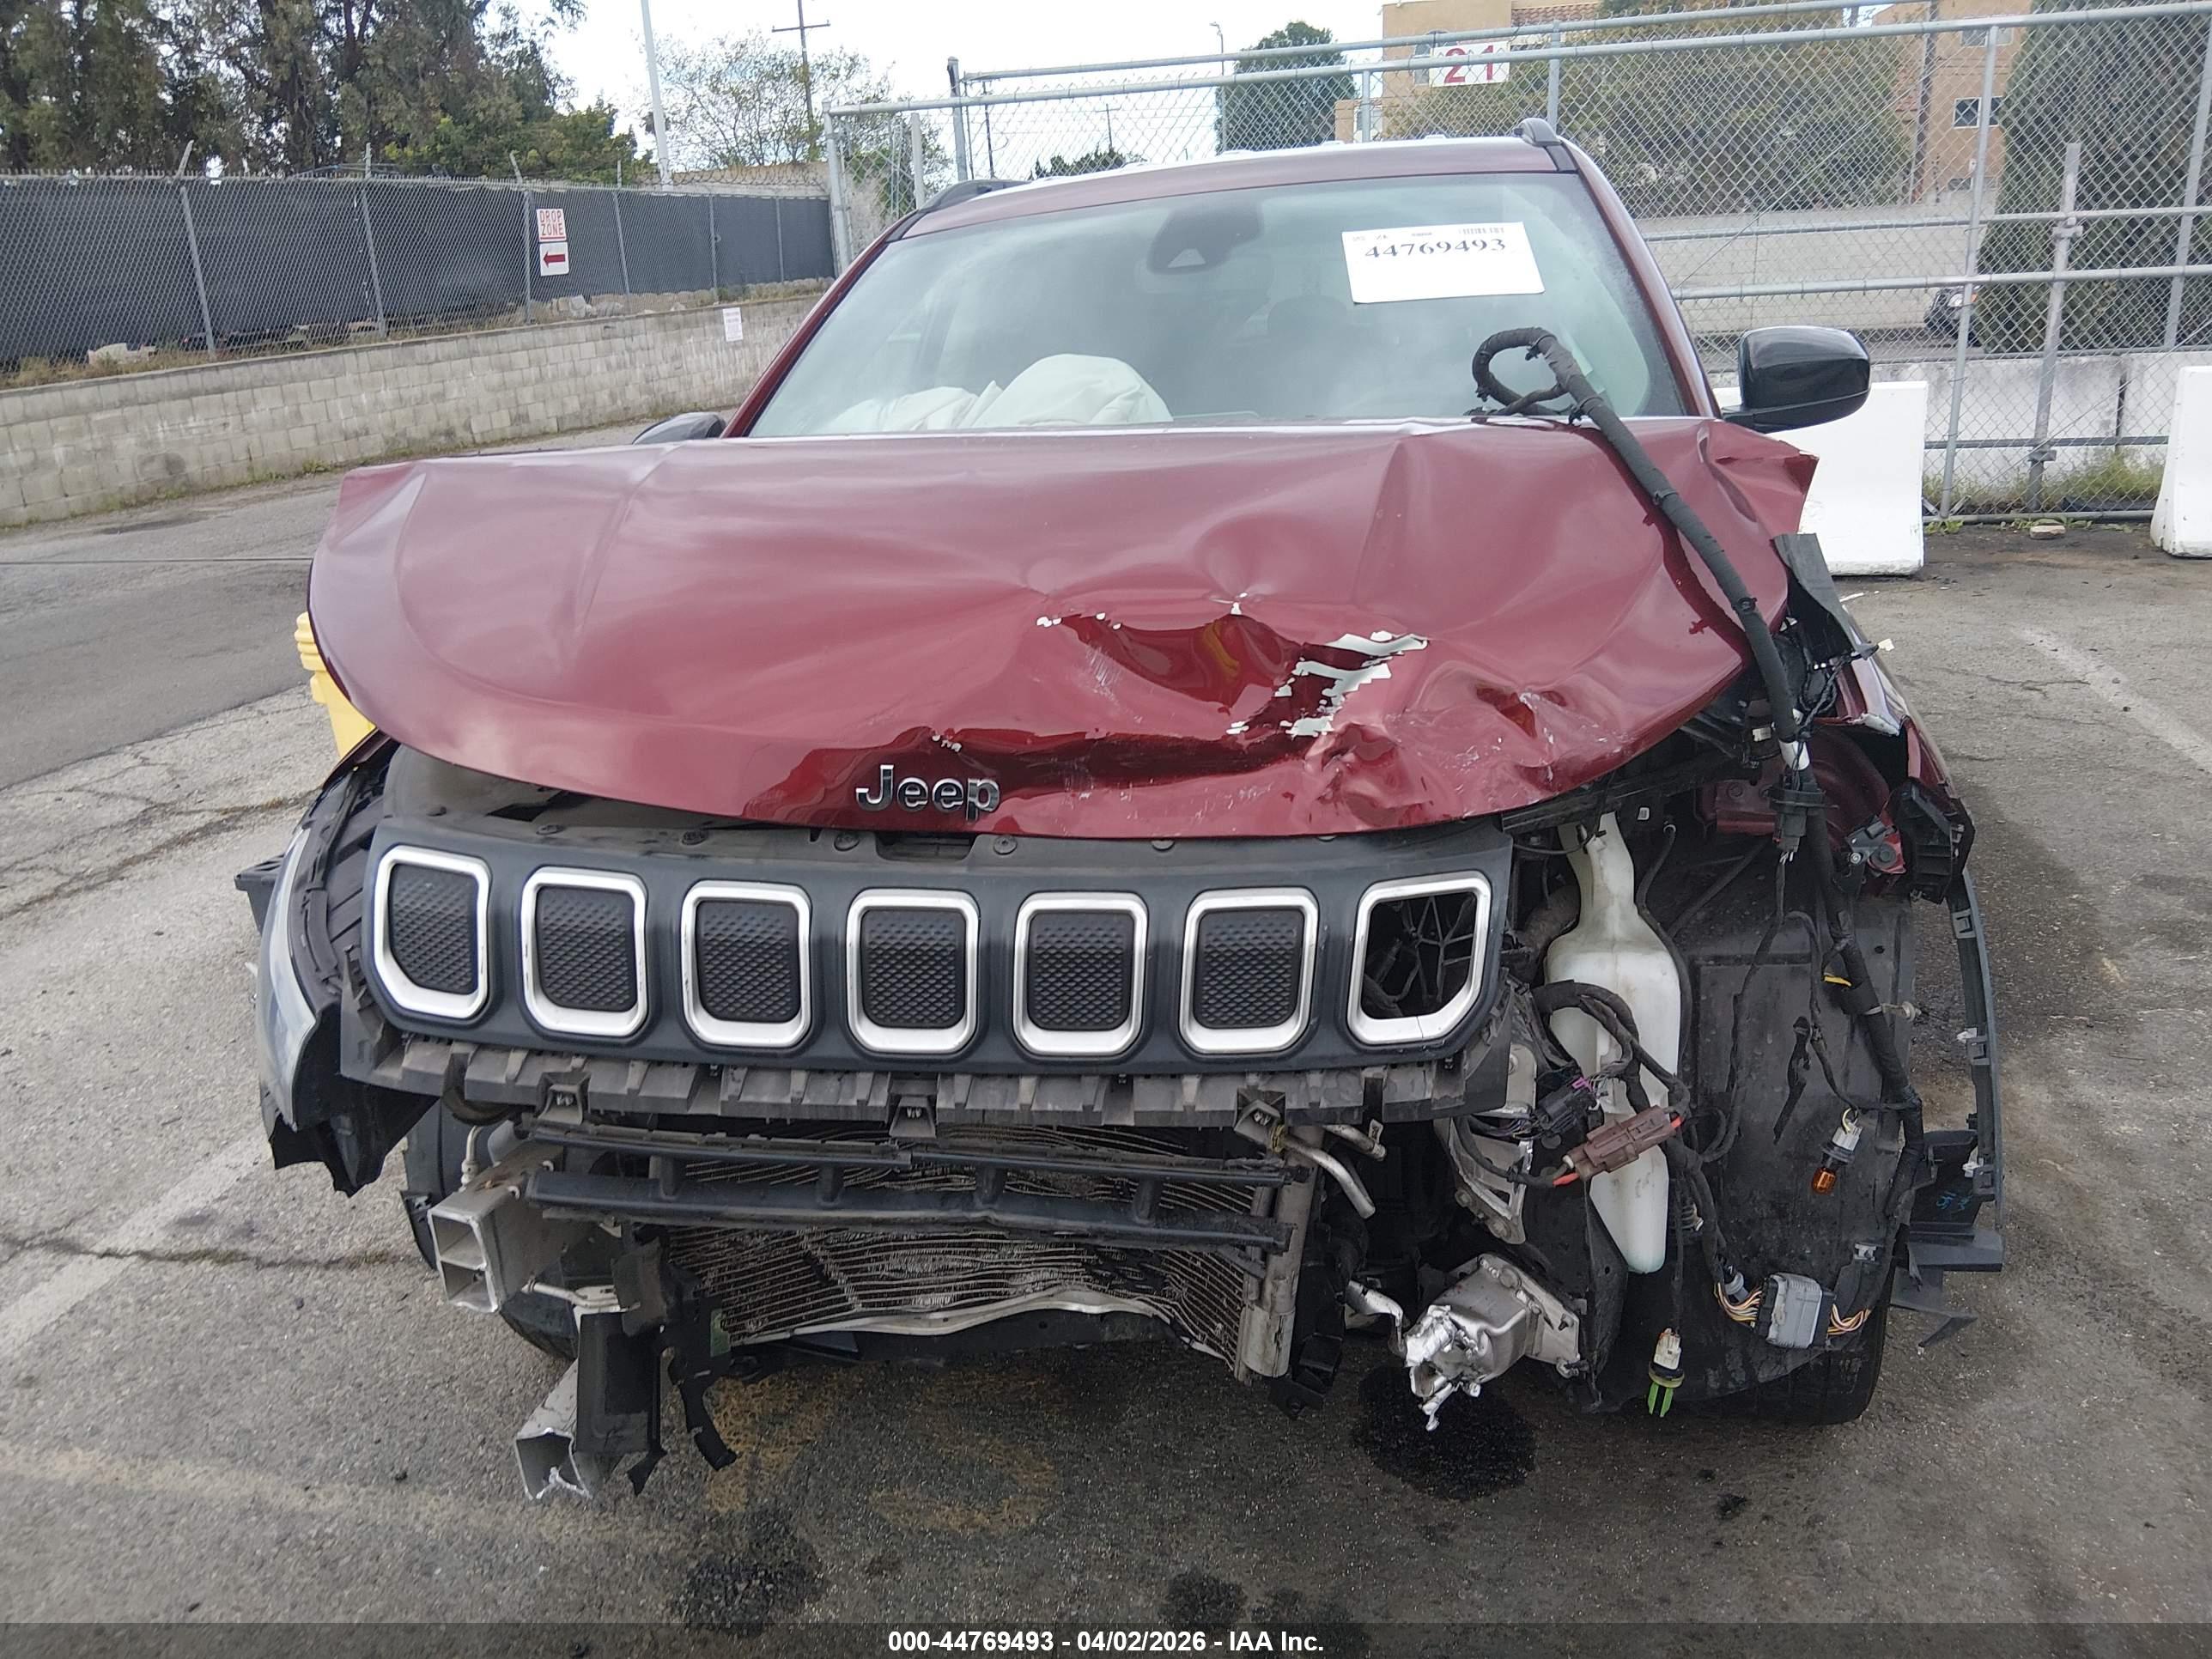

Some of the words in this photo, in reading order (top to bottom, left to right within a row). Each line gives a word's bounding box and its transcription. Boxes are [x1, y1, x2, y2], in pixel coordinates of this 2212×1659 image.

[1443, 45, 1494, 83] 21
[539, 210, 562, 222] DROP
[541, 222, 564, 236] ZONE
[1364, 238, 1506, 258] 44769493
[854, 763, 1000, 823] Jeep
